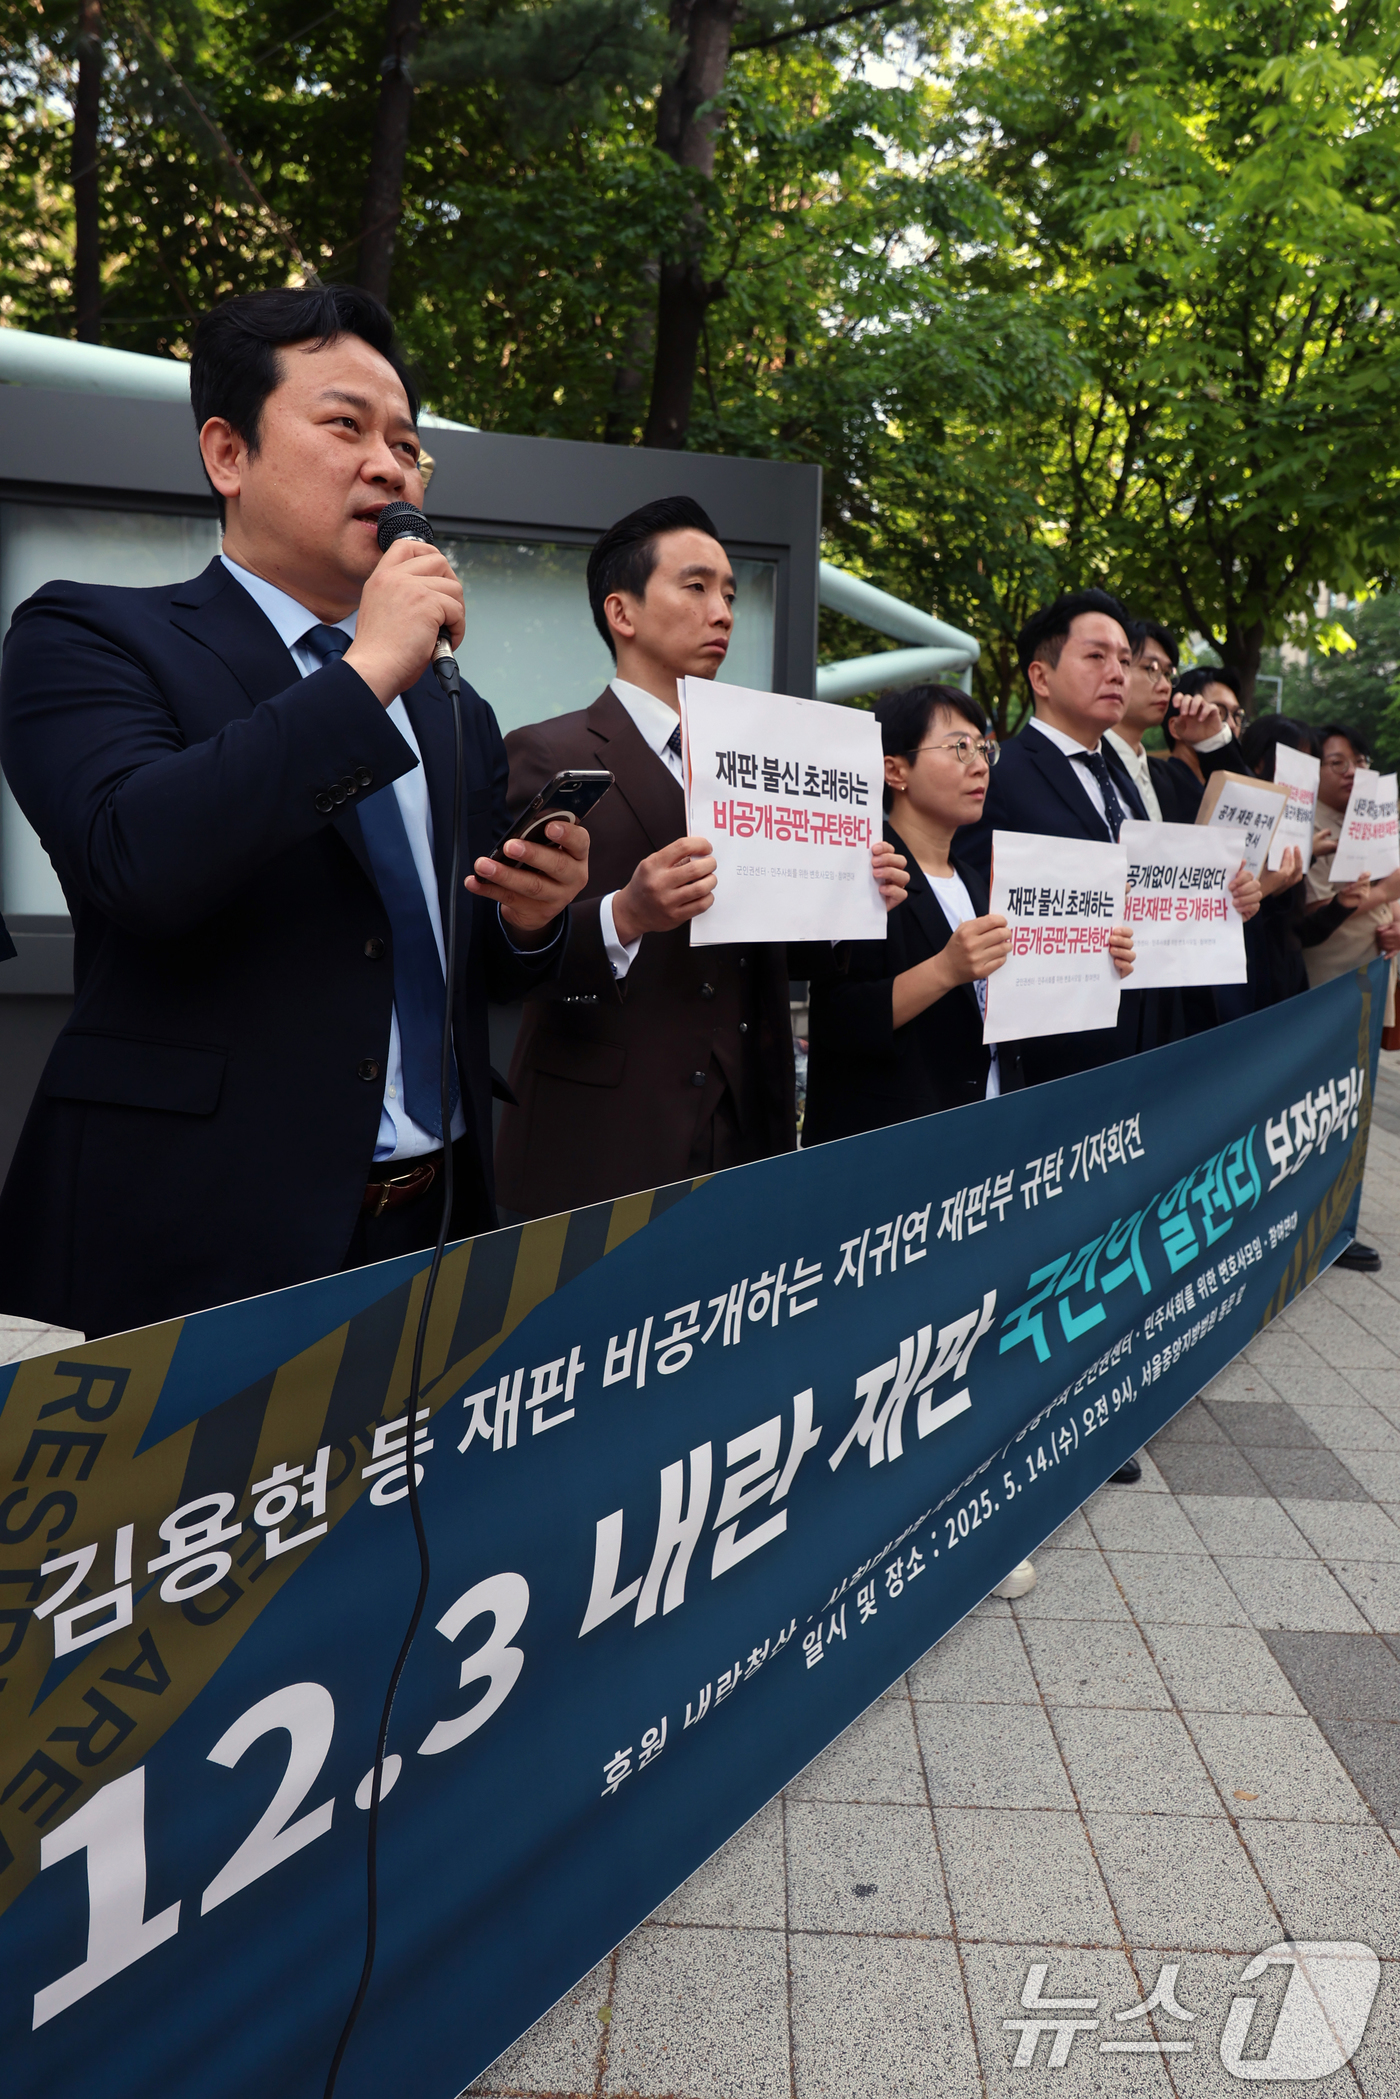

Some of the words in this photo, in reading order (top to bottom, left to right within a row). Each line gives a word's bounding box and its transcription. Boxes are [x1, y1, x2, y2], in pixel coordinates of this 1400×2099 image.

[716, 751, 758, 789] 재판
[762, 757, 799, 795] 불신
[803, 766, 868, 805] 초래하는
[1008, 887, 1036, 916] 재판
[1038, 888, 1065, 916] 불신
[1066, 890, 1114, 917] 초래하는
[1127, 865, 1178, 889] 공개없이
[1178, 867, 1226, 890] 신뢰없다
[1175, 898, 1228, 922] 공개하라
[33, 1445, 331, 1659] 김용현
[362, 1408, 434, 1506] 등
[457, 1345, 585, 1454] 재판
[603, 1258, 823, 1389] 비공개하는
[834, 1203, 931, 1287] 지귀연
[937, 1169, 1014, 1242] 재판부
[1020, 1147, 1063, 1209] 규탄
[1069, 1113, 1145, 1181] 기자회견
[578, 1388, 822, 1638] 내란
[828, 1289, 997, 1471] 재판
[999, 1193, 1162, 1363] 국민의
[1265, 1067, 1365, 1192] 보장하라!
[601, 1716, 667, 1796] 후원
[1144, 1284, 1196, 1341] 민주사회를
[1197, 1267, 1218, 1300] 위한
[1218, 1236, 1262, 1285] 변호사모임
[803, 1603, 846, 1669] 일시
[858, 1579, 877, 1624] 및
[886, 1546, 925, 1597] 장소
[945, 1489, 1000, 1550] 2025.
[1083, 1395, 1108, 1436] 오전
[1112, 1376, 1137, 1412] 9시,
